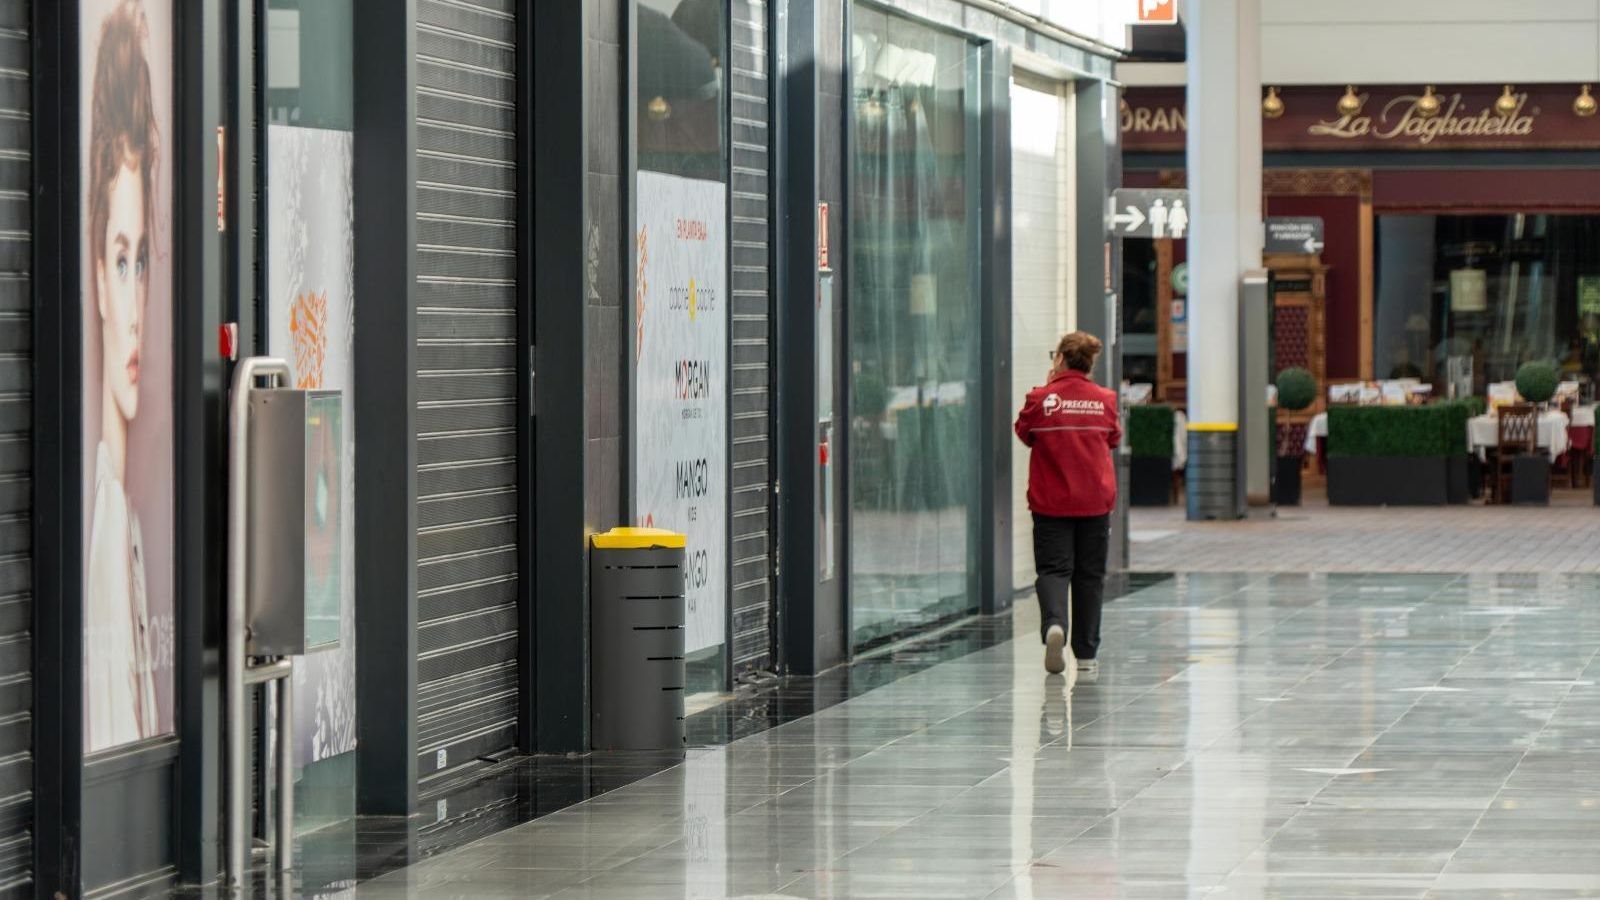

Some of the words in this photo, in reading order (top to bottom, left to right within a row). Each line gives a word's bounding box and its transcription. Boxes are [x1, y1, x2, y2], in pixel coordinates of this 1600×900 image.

[1372, 93, 1534, 145] Tagliatella
[675, 359, 710, 400] MORGAN
[676, 458, 708, 500] MANGO
[684, 549, 708, 590] ANGO
